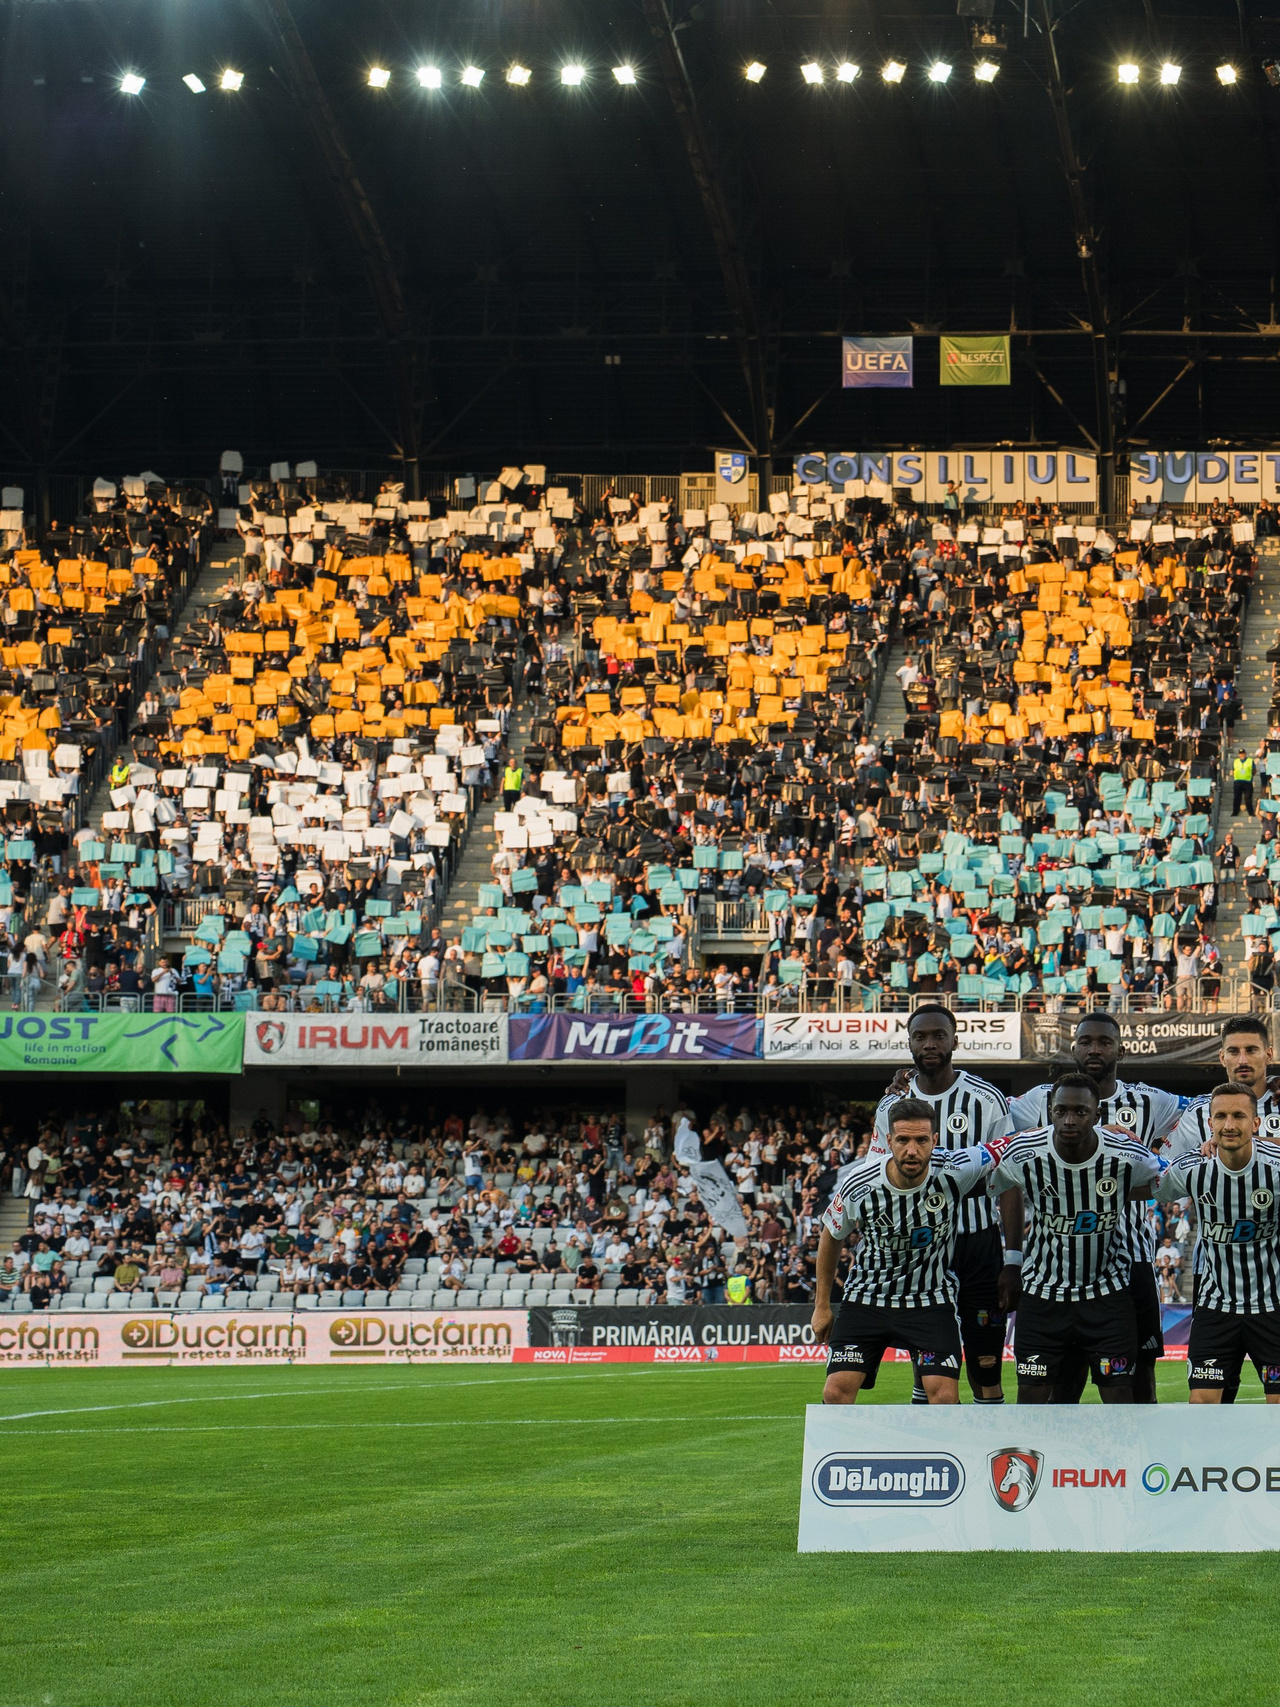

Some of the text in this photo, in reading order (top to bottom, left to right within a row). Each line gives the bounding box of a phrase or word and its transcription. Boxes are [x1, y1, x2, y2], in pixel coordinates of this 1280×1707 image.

[846, 353, 908, 371] UEFA
[960, 353, 1004, 365] RESPECT
[796, 454, 1090, 485] CONSILIUL
[0, 1017, 98, 1040] JOST
[419, 1019, 498, 1034] Tractoare
[808, 1019, 1005, 1033] RUBIN MORS
[1151, 1023, 1218, 1037] CONSILIUL
[298, 1026, 409, 1049] IRUM
[564, 1013, 708, 1054] MrBit
[24, 1043, 107, 1054] life in motion
[819, 1039, 843, 1051] Noi
[849, 1039, 861, 1051] &
[24, 1055, 77, 1065] Romania
[972, 1087, 995, 1104] AROBS
[952, 1118, 963, 1128] U
[1121, 1113, 1131, 1123] U
[1269, 1119, 1279, 1128] U
[1118, 1151, 1144, 1162] AROBS
[1102, 1182, 1112, 1193] U
[928, 1195, 941, 1207] U
[1257, 1193, 1267, 1204] U
[1043, 1210, 1118, 1236] MrBit
[880, 1220, 951, 1252] MrBit
[1201, 1219, 1277, 1244] MrBit
[155, 1319, 307, 1348] Ducfarm
[362, 1317, 512, 1346] Ducfarm
[592, 1320, 816, 1346] PRIMĂRIA CLUJ-NAPO
[182, 1350, 231, 1361] rețeta
[388, 1348, 437, 1360] rețeta
[534, 1350, 567, 1359] NOVA
[654, 1347, 702, 1358] NOVA
[779, 1346, 828, 1357] NOVA
[1018, 1363, 1047, 1371] RUBIN
[1194, 1367, 1224, 1375] RUBIN
[1052, 1468, 1126, 1488] IRUM
